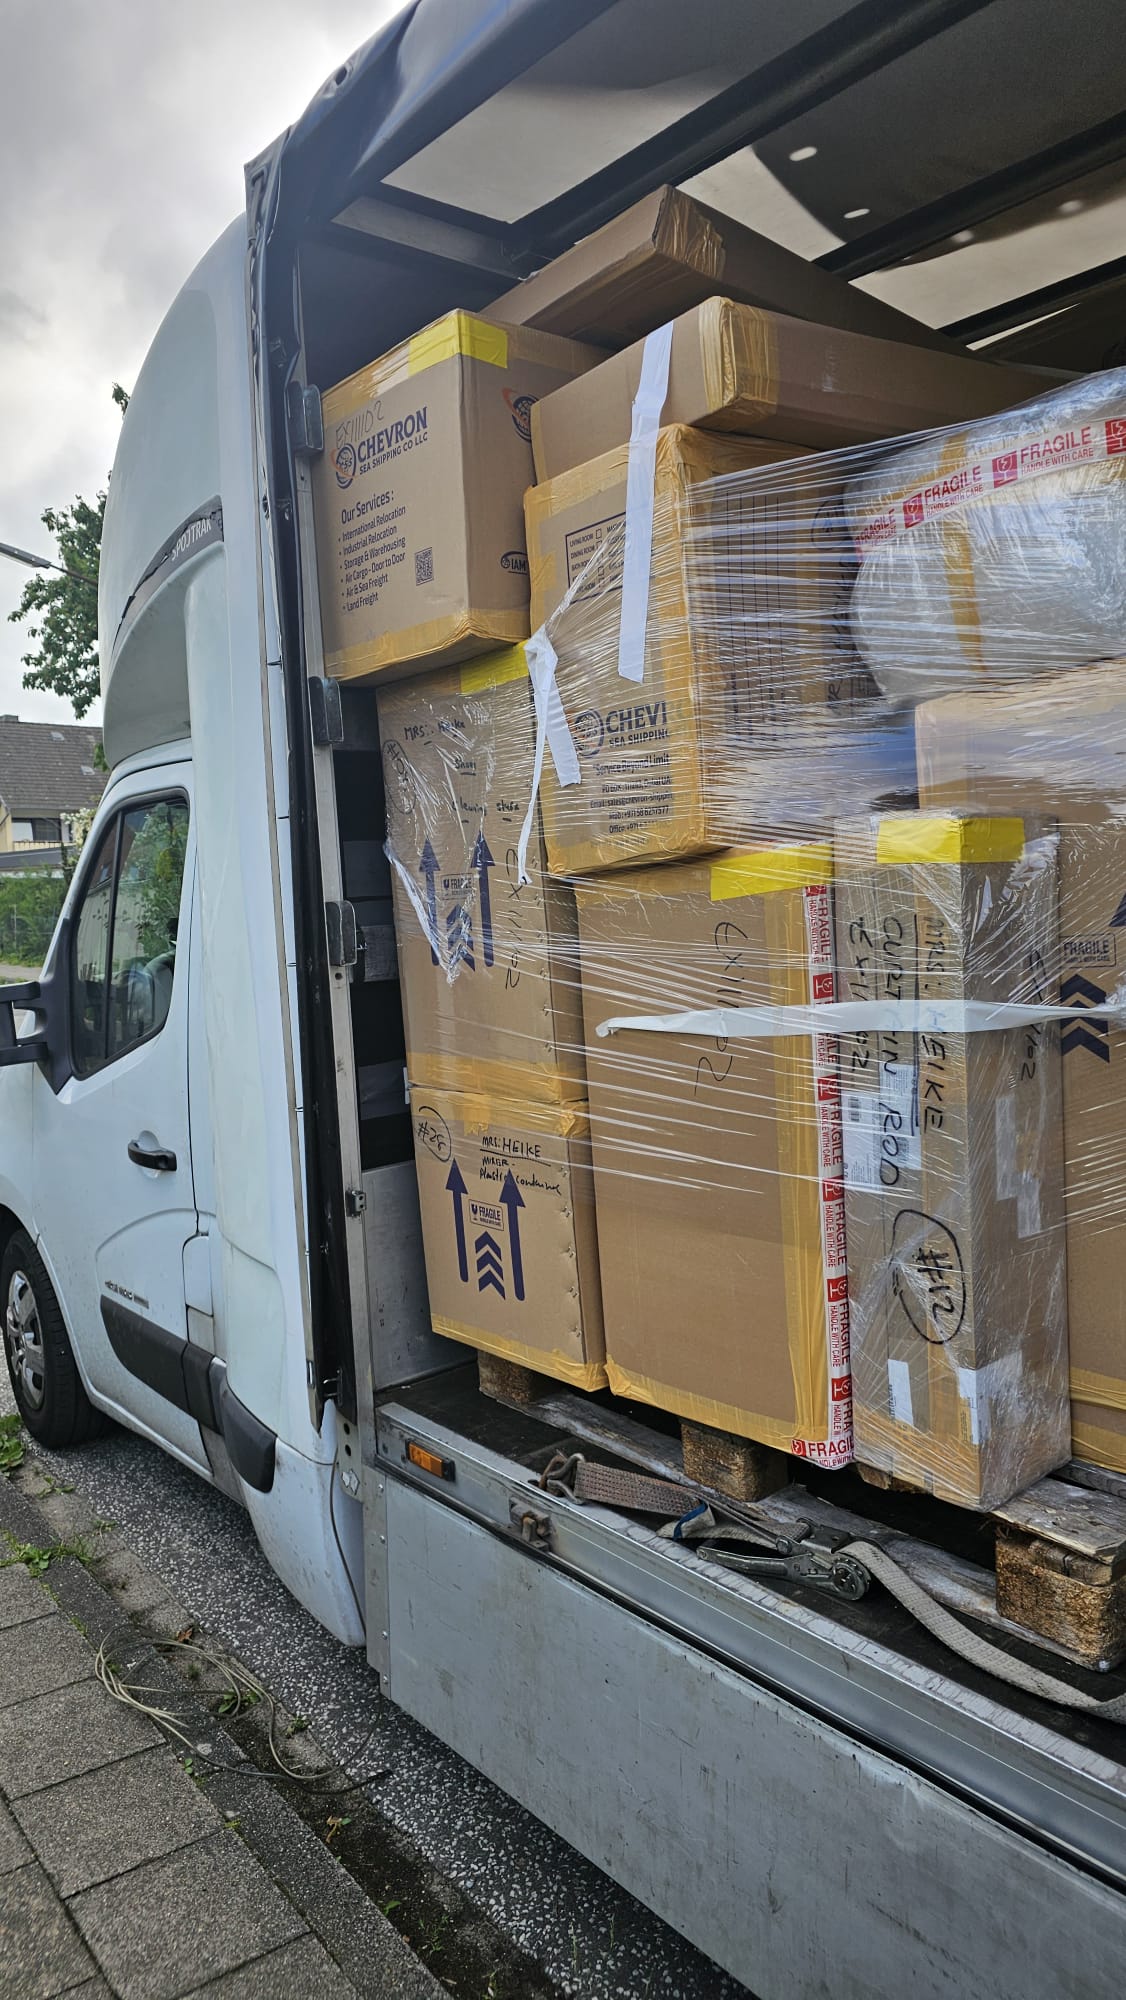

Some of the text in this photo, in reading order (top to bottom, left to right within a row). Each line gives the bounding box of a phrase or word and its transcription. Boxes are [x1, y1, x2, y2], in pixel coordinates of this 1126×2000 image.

[357, 407, 427, 463] CHEVRON
[1020, 427, 1091, 464] FRAGILE
[360, 432, 428, 475] SEA SHIPPING CO LLC
[1051, 453, 1071, 468] WITH
[1072, 447, 1094, 463] CARE
[923, 465, 982, 505] FRAGILE
[966, 484, 983, 500] CARE
[341, 507, 355, 525] Our
[342, 506, 406, 542] International Relocation
[343, 525, 397, 556] Industrial Relocation
[344, 536, 406, 570] Storage & Warehousing
[569, 533, 594, 548] LIVING ROOM
[583, 545, 595, 555] ROOM
[353, 567, 368, 582] Cargo
[372, 561, 384, 573] Door
[385, 557, 391, 567] to
[392, 552, 406, 565] Door
[511, 556, 528, 572] IAM
[358, 581, 368, 594] Sea
[369, 573, 388, 588] Freight
[347, 592, 378, 611] Land Freight
[818, 898, 831, 963] FRAGILE
[502, 1139, 542, 1158] HEIKE
[820, 1104, 831, 1167] HANDLE WITH CARE
[830, 1102, 843, 1166] FRAGILE
[880, 1102, 902, 1186] ROD
[479, 1205, 501, 1221] FRAGILE
[825, 1205, 836, 1267] HANDLE WITH CARE
[835, 1202, 847, 1266] FRAGILE
[830, 1305, 841, 1367] HANDLE WITH CARE
[839, 1302, 850, 1365] FRAGILE
[842, 1401, 853, 1433] FRA
